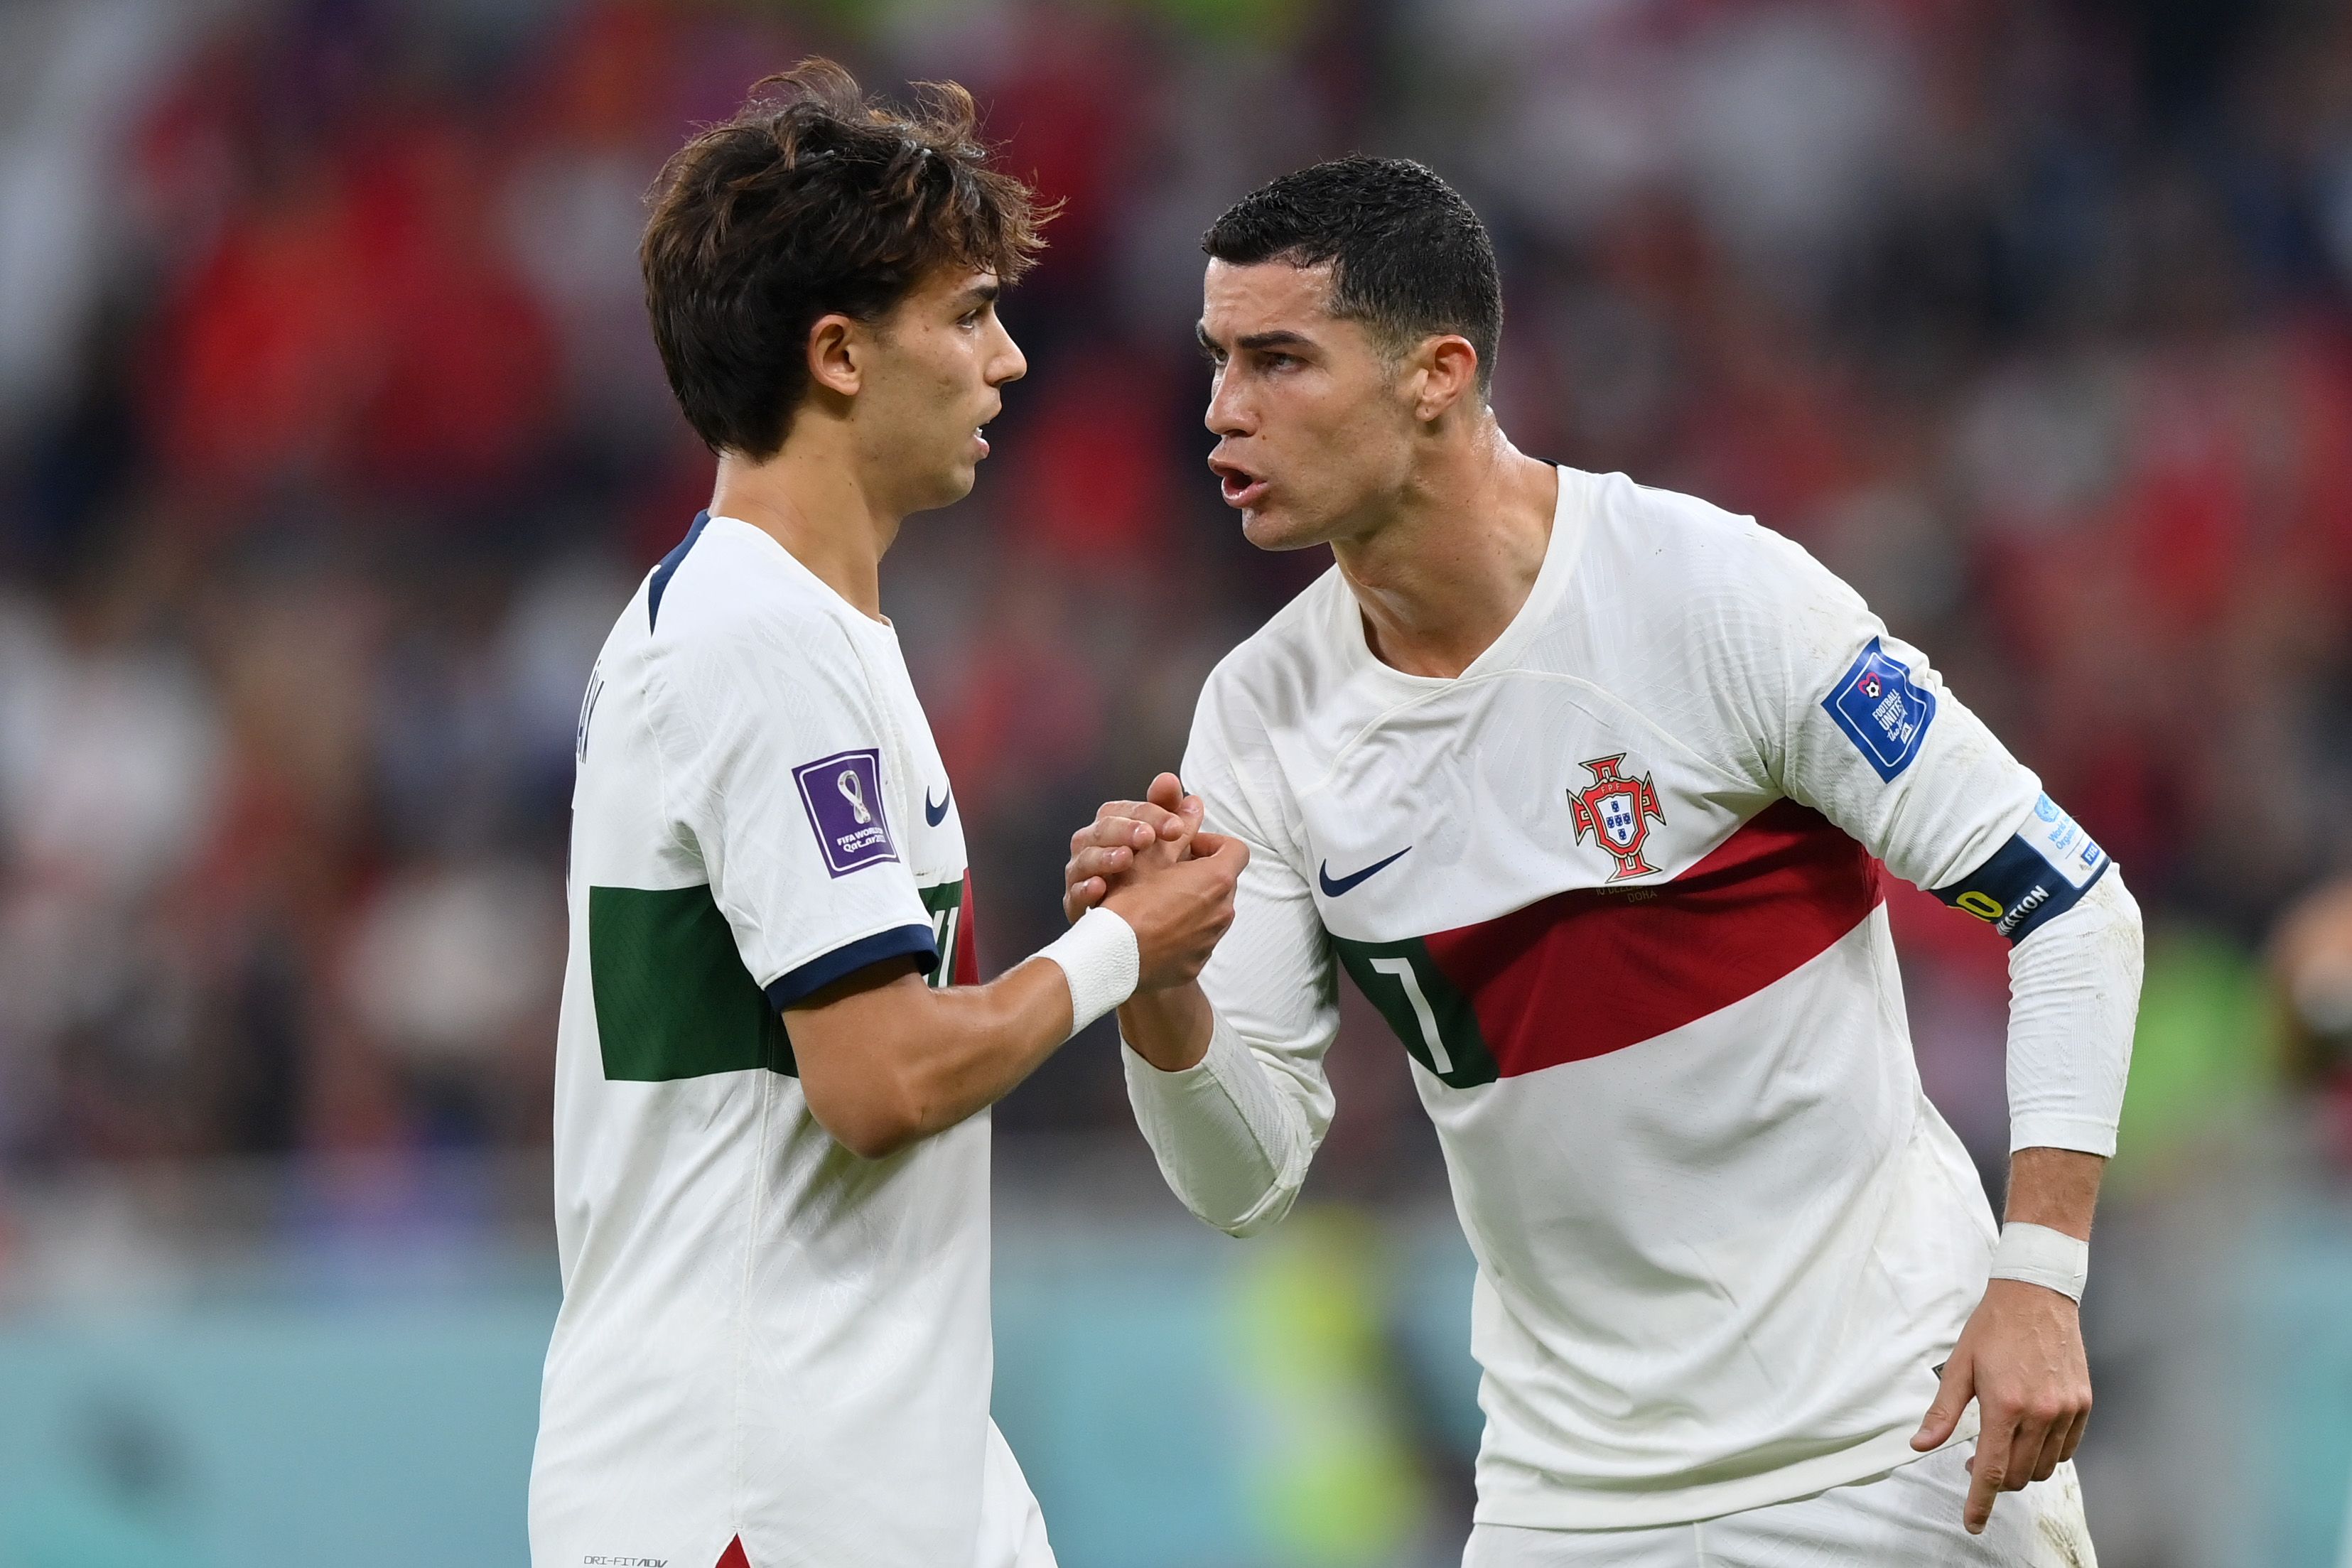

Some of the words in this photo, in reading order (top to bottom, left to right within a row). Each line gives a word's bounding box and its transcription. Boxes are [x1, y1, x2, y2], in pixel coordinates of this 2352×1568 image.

[1872, 688, 1900, 721] FOOTBALL
[836, 834, 856, 846] FIFA
[2047, 823, 2066, 843] World
[2086, 845, 2098, 862] FIFA
[1627, 888, 1658, 903] DOHA
[1369, 957, 1454, 1074] 7
